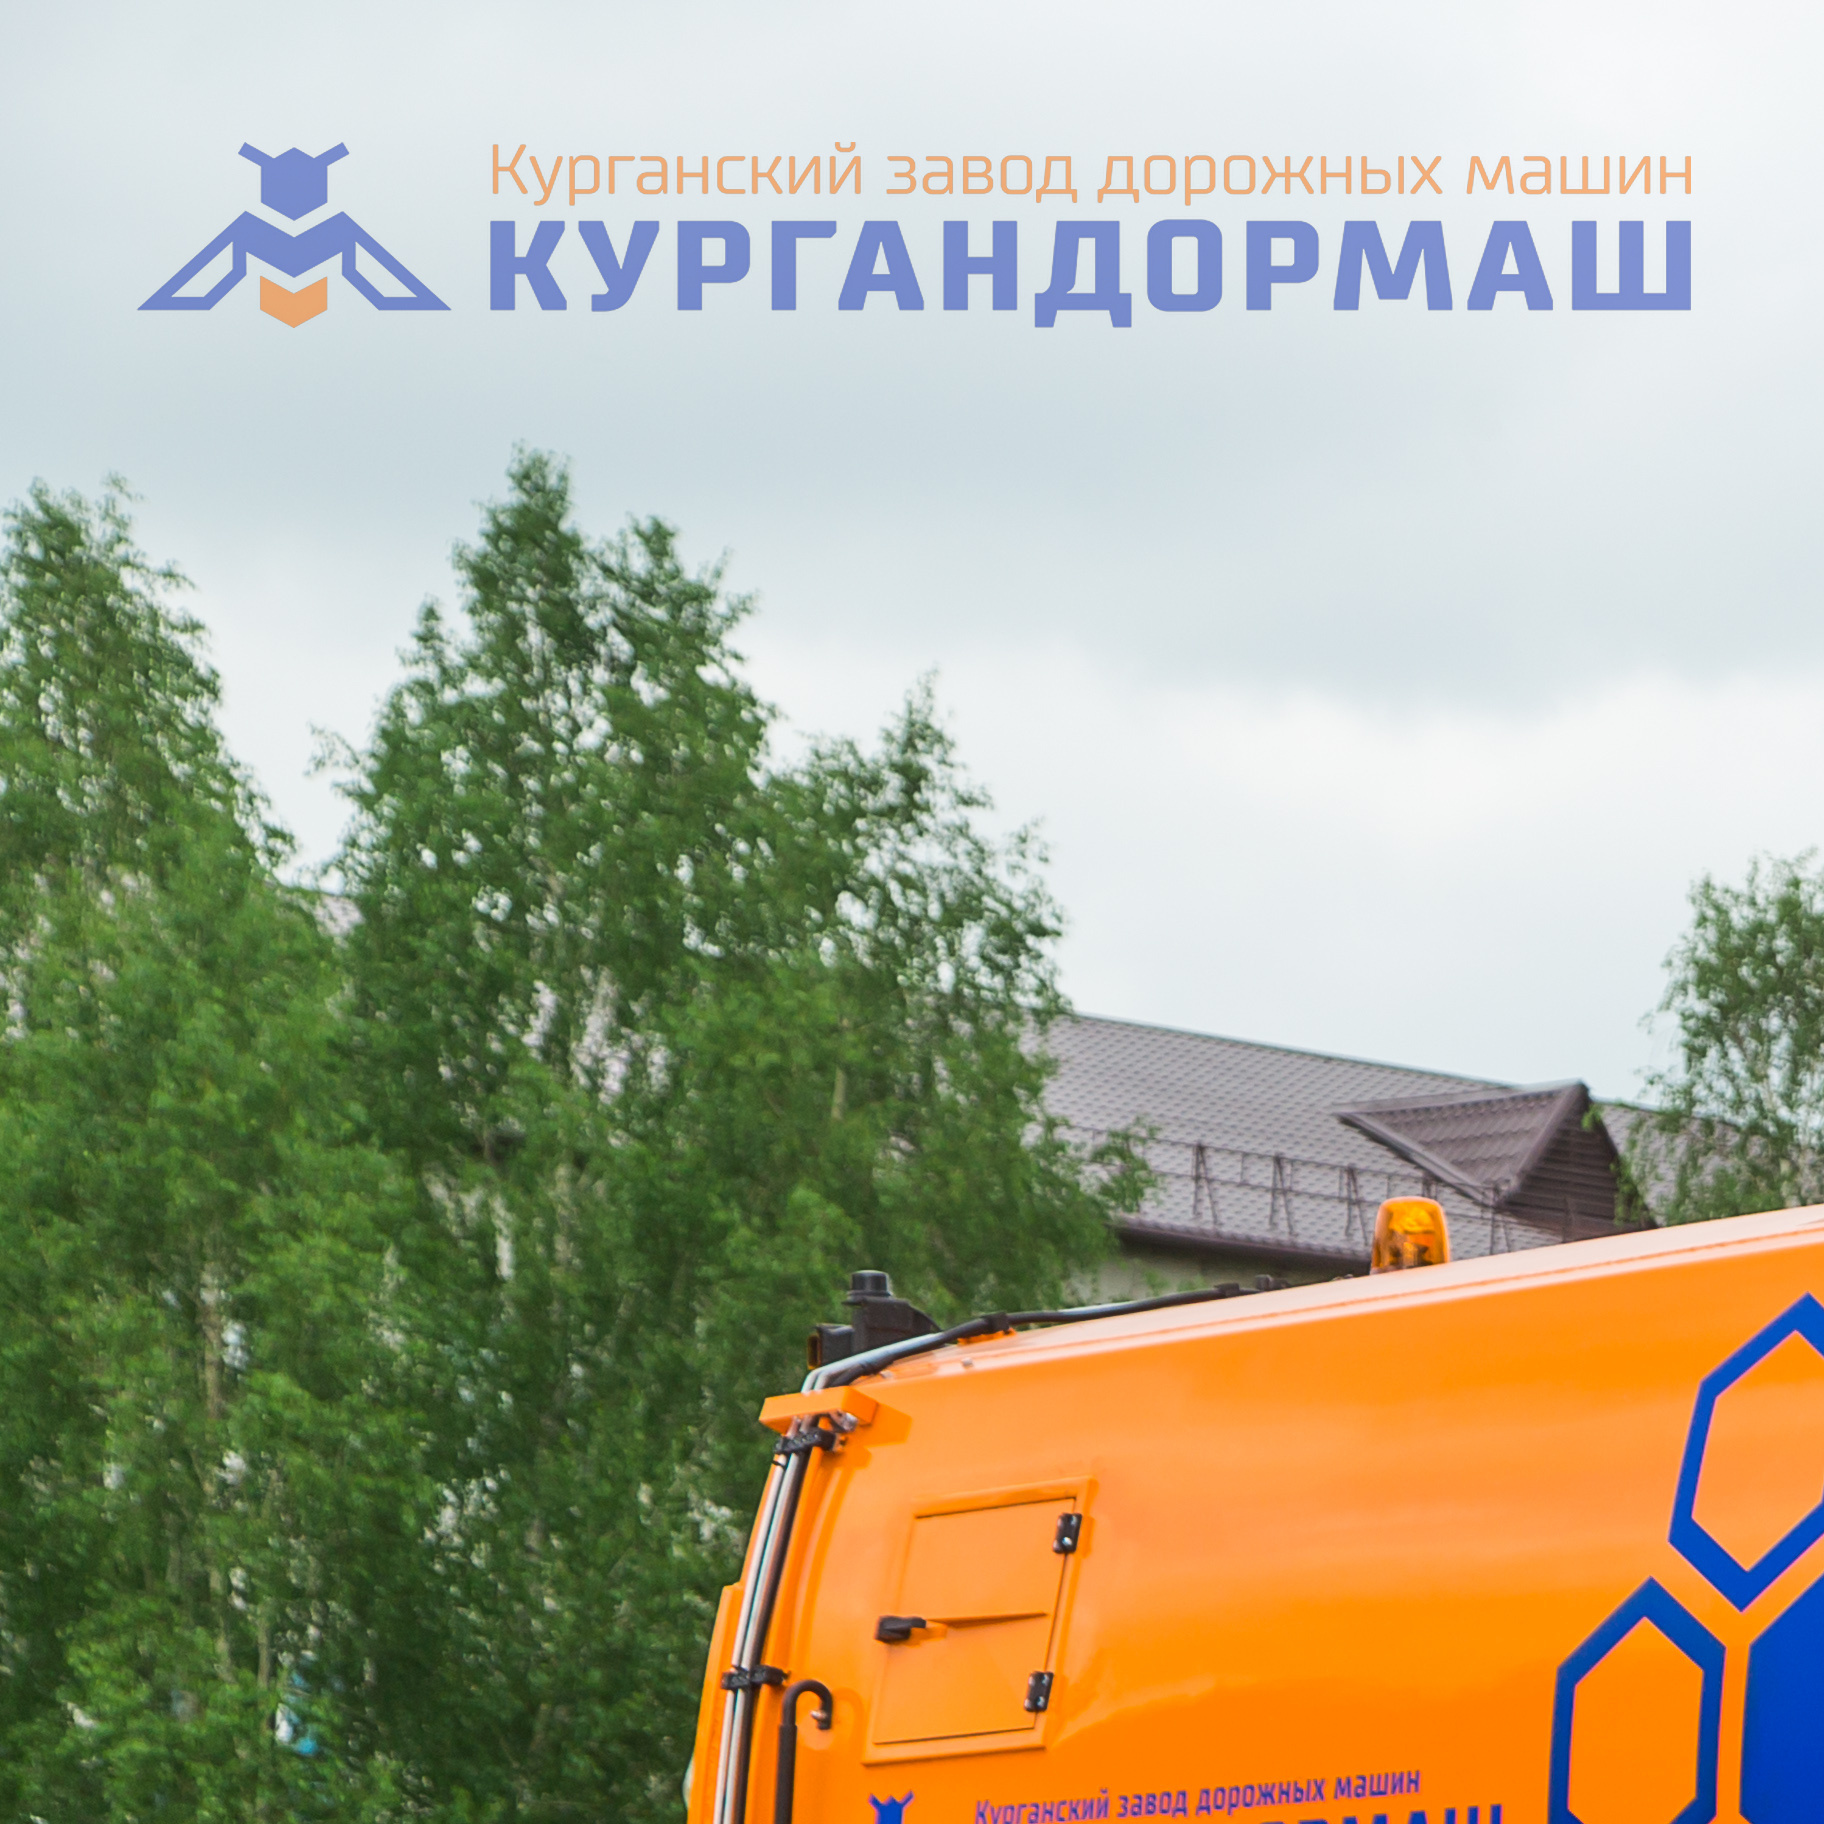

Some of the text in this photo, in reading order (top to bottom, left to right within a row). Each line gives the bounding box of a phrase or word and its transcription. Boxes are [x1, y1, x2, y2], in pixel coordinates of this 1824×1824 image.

[1116, 1791, 1188, 1819] завод
[1195, 1778, 1326, 1816] дорожных
[1333, 1770, 1421, 1800] машин
